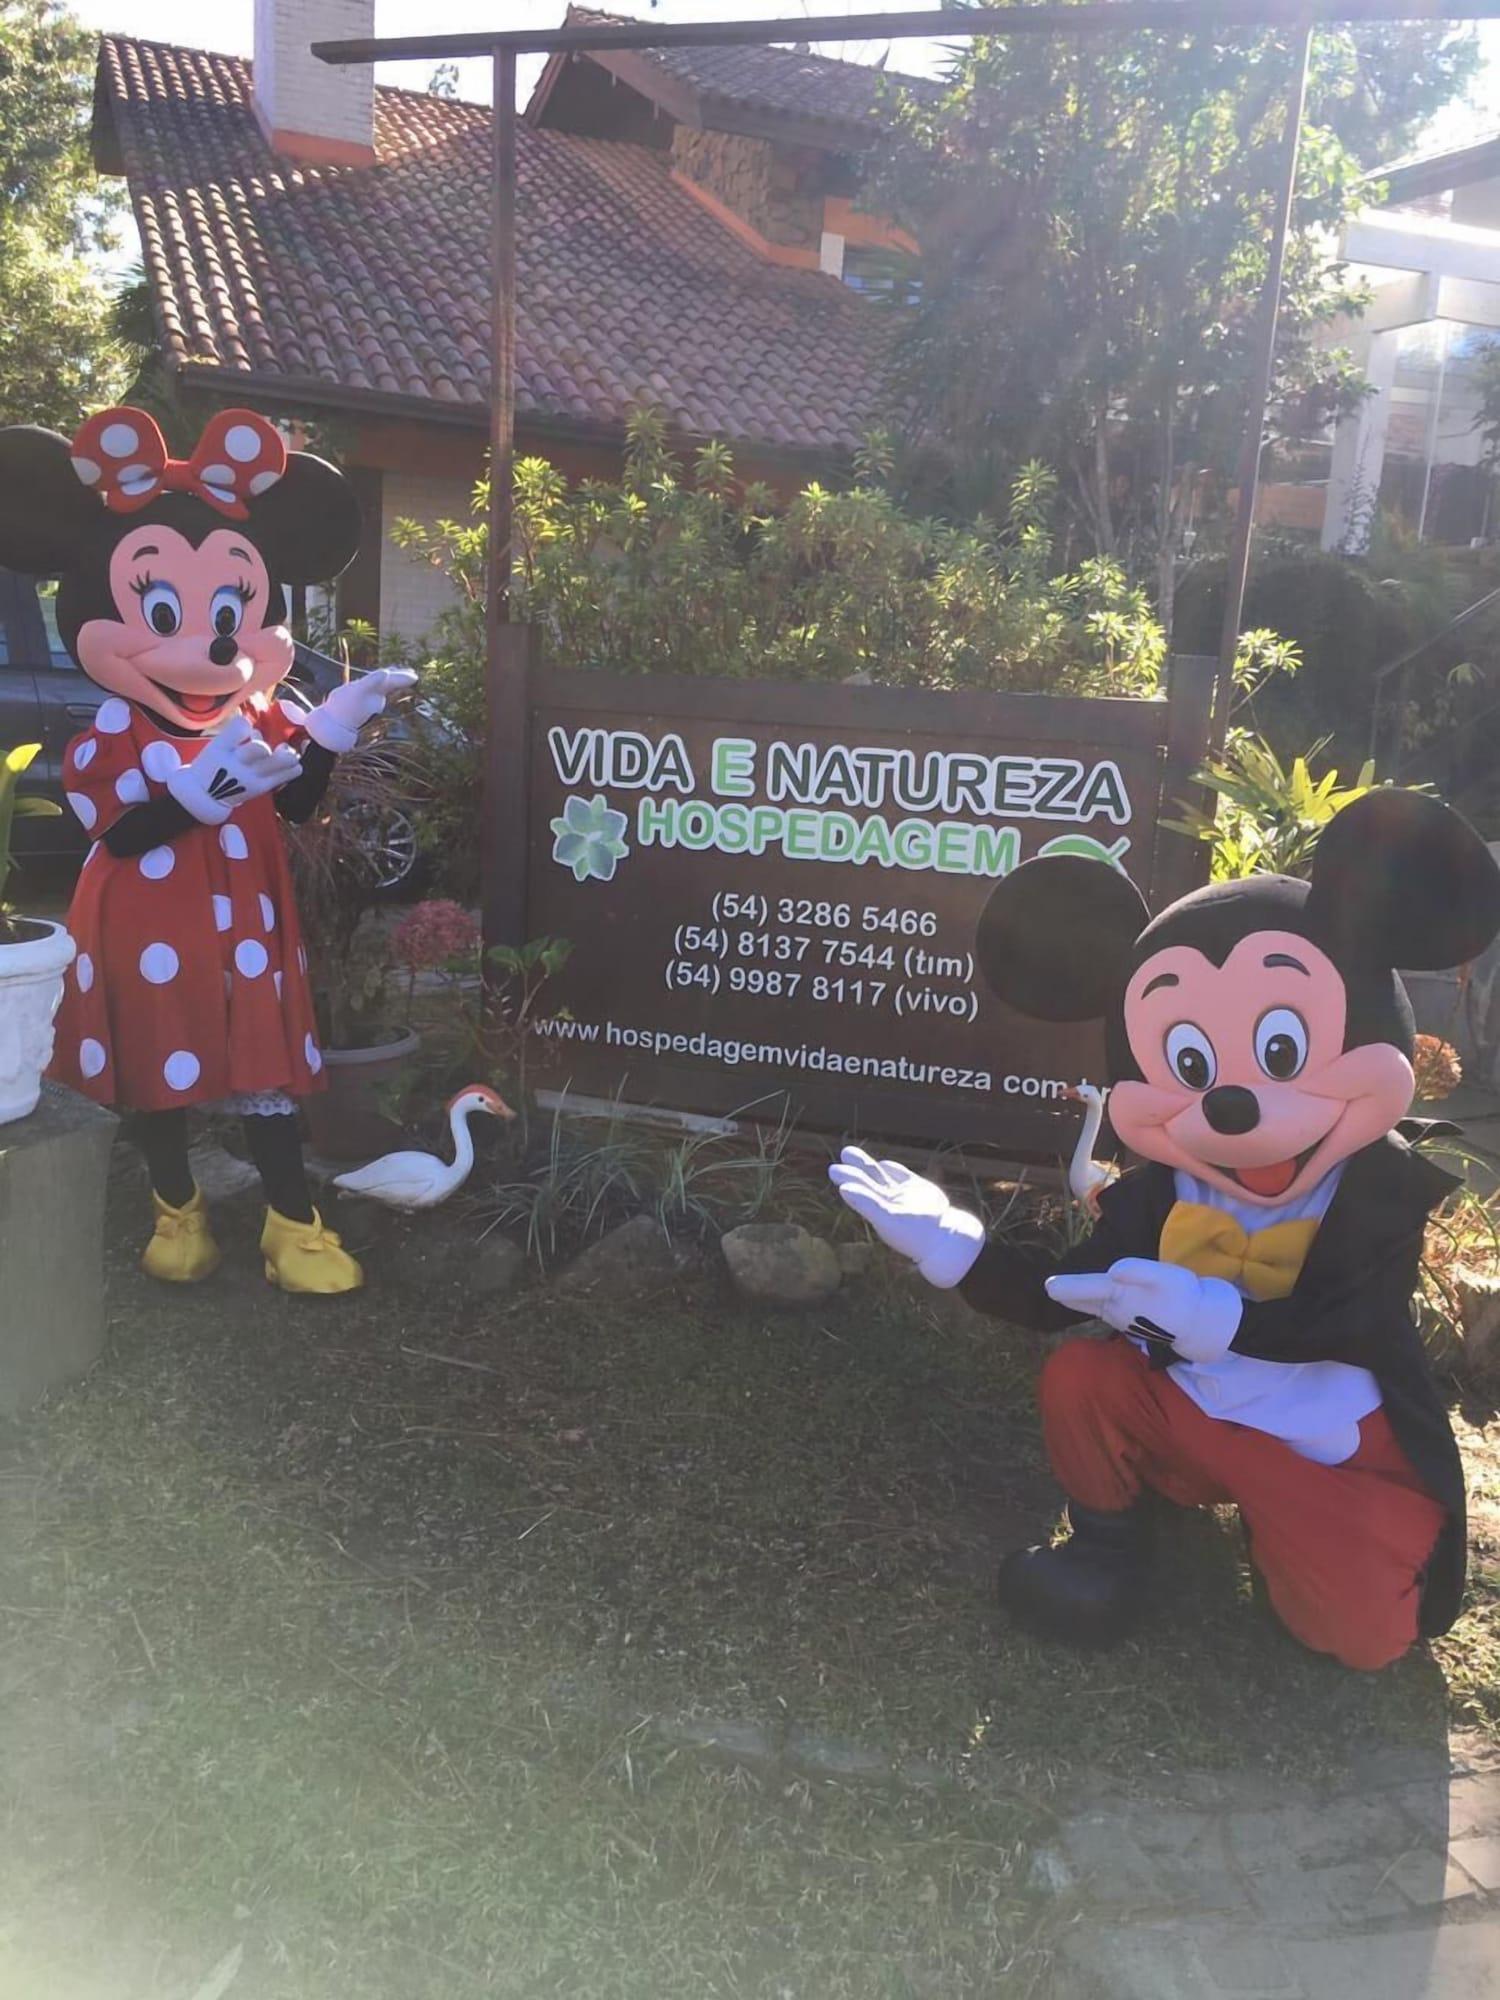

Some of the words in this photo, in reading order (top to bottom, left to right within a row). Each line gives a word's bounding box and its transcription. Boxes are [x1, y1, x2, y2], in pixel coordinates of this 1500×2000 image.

[548, 727, 695, 794] VIDA
[711, 738, 757, 797] E
[767, 741, 1131, 825] NATUREZA
[638, 797, 1021, 877] HOSPEDAGEM
[708, 891, 768, 926] (54)
[777, 898, 850, 928] 3286
[862, 906, 937, 937] 5466
[674, 924, 729, 959] (54)
[737, 931, 810, 961] 8137
[822, 939, 895, 971] 7544
[904, 946, 974, 984] (tim)
[665, 959, 721, 995] (54)
[729, 967, 801, 997] 9987
[812, 976, 886, 1007] 8117
[895, 984, 978, 1023] (vivo)
